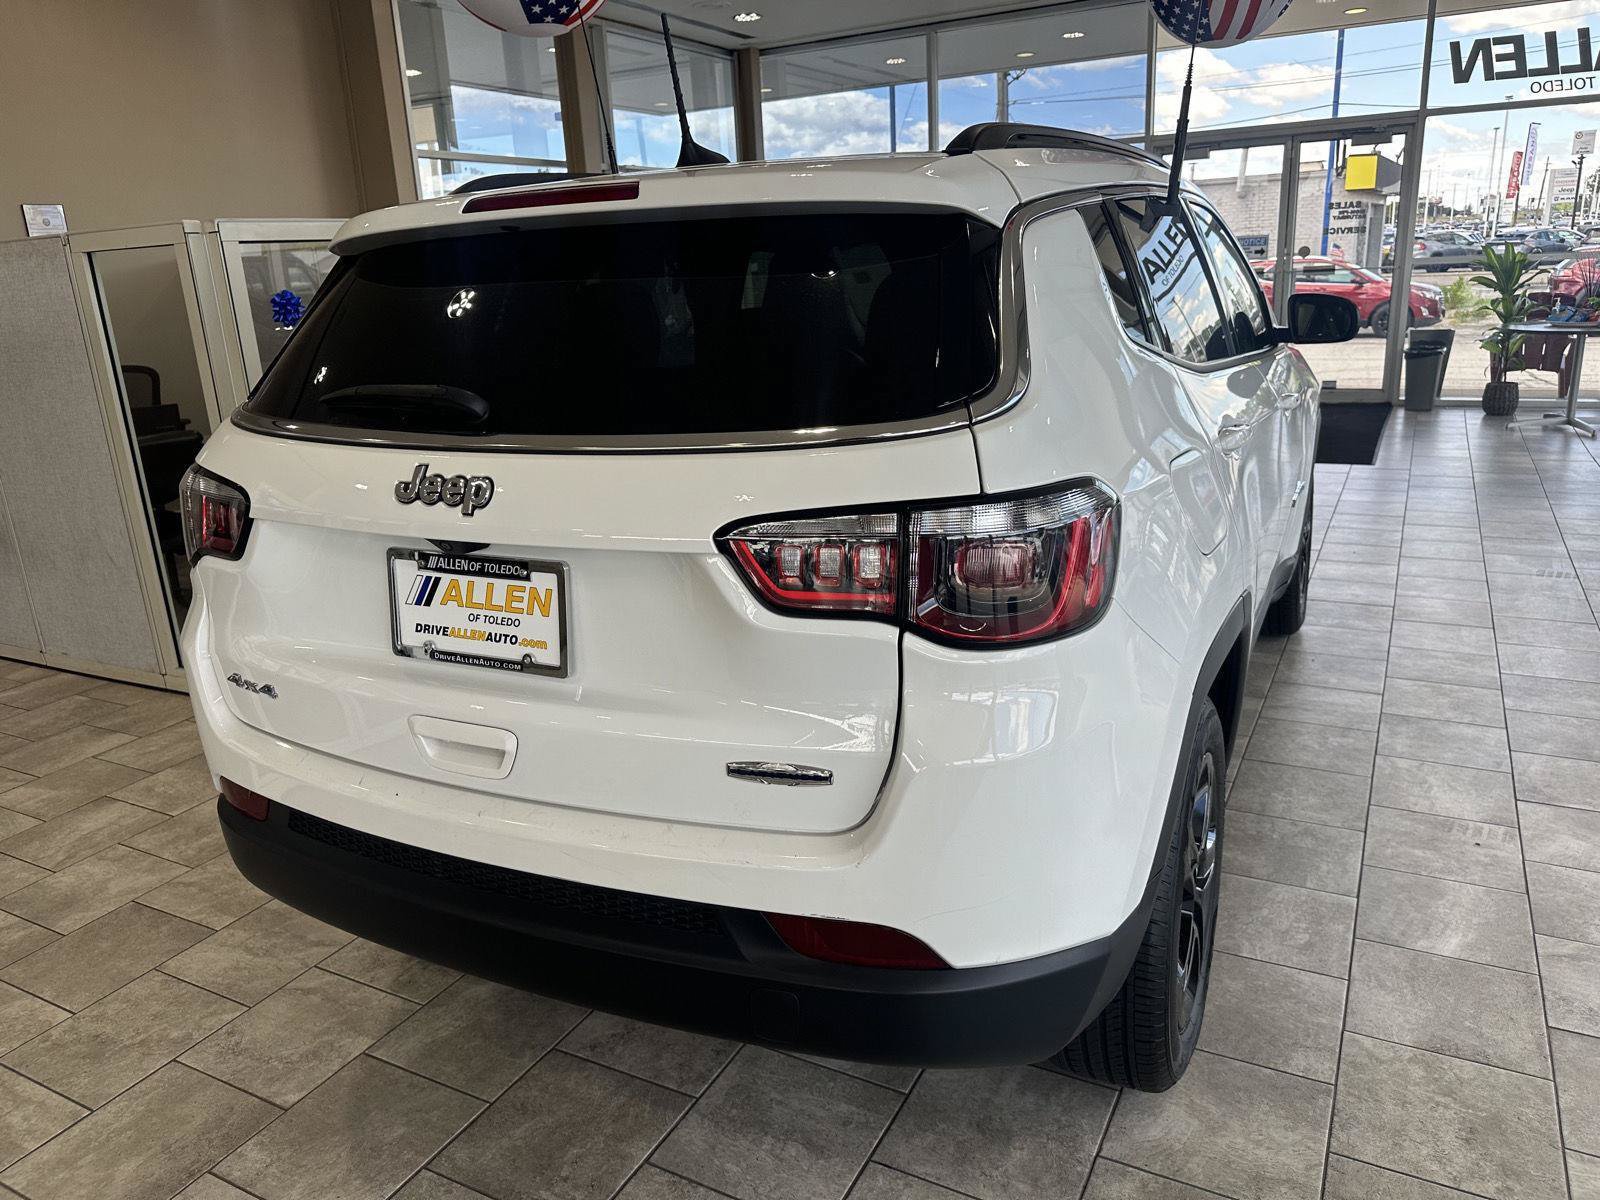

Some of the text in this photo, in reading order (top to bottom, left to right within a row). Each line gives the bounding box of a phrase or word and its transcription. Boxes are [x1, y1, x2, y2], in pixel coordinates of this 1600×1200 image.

[394, 463, 495, 517] Jeep
[437, 557, 520, 576] ALLEN OF TOLEDO
[440, 578, 553, 618] ALLEN
[467, 613, 521, 628] OF TOLEDO
